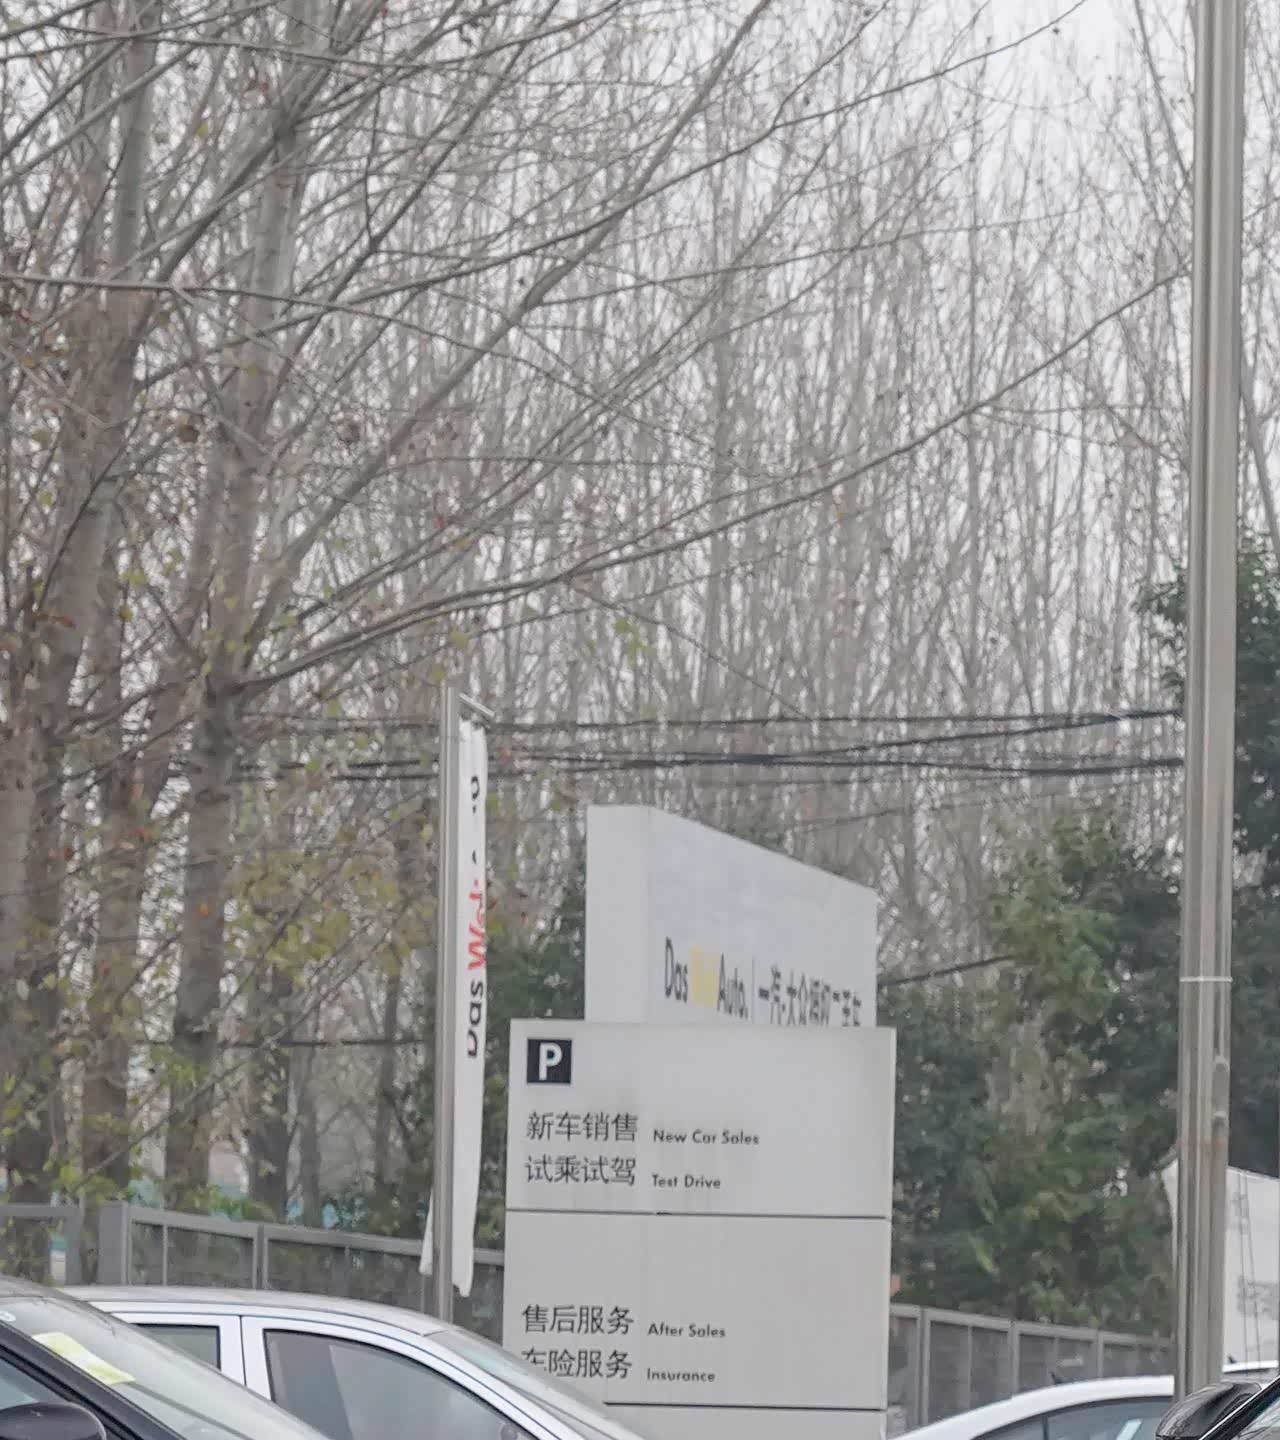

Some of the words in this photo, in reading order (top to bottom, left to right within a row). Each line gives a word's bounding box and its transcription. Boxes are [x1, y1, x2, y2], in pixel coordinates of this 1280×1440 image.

[664, 935, 688, 1003] Das
[527, 1110, 638, 1142] 新车销售
[653, 1129, 686, 1144] New
[692, 1129, 717, 1144] Car
[721, 1129, 760, 1145] Sales
[525, 1154, 637, 1187] 试乘试驾
[651, 1173, 678, 1188] Test
[684, 1174, 722, 1189] Drive
[521, 1303, 634, 1335] 售后服务
[647, 1323, 682, 1338] After
[688, 1323, 726, 1339] Sales
[647, 1367, 716, 1382] Insurance
